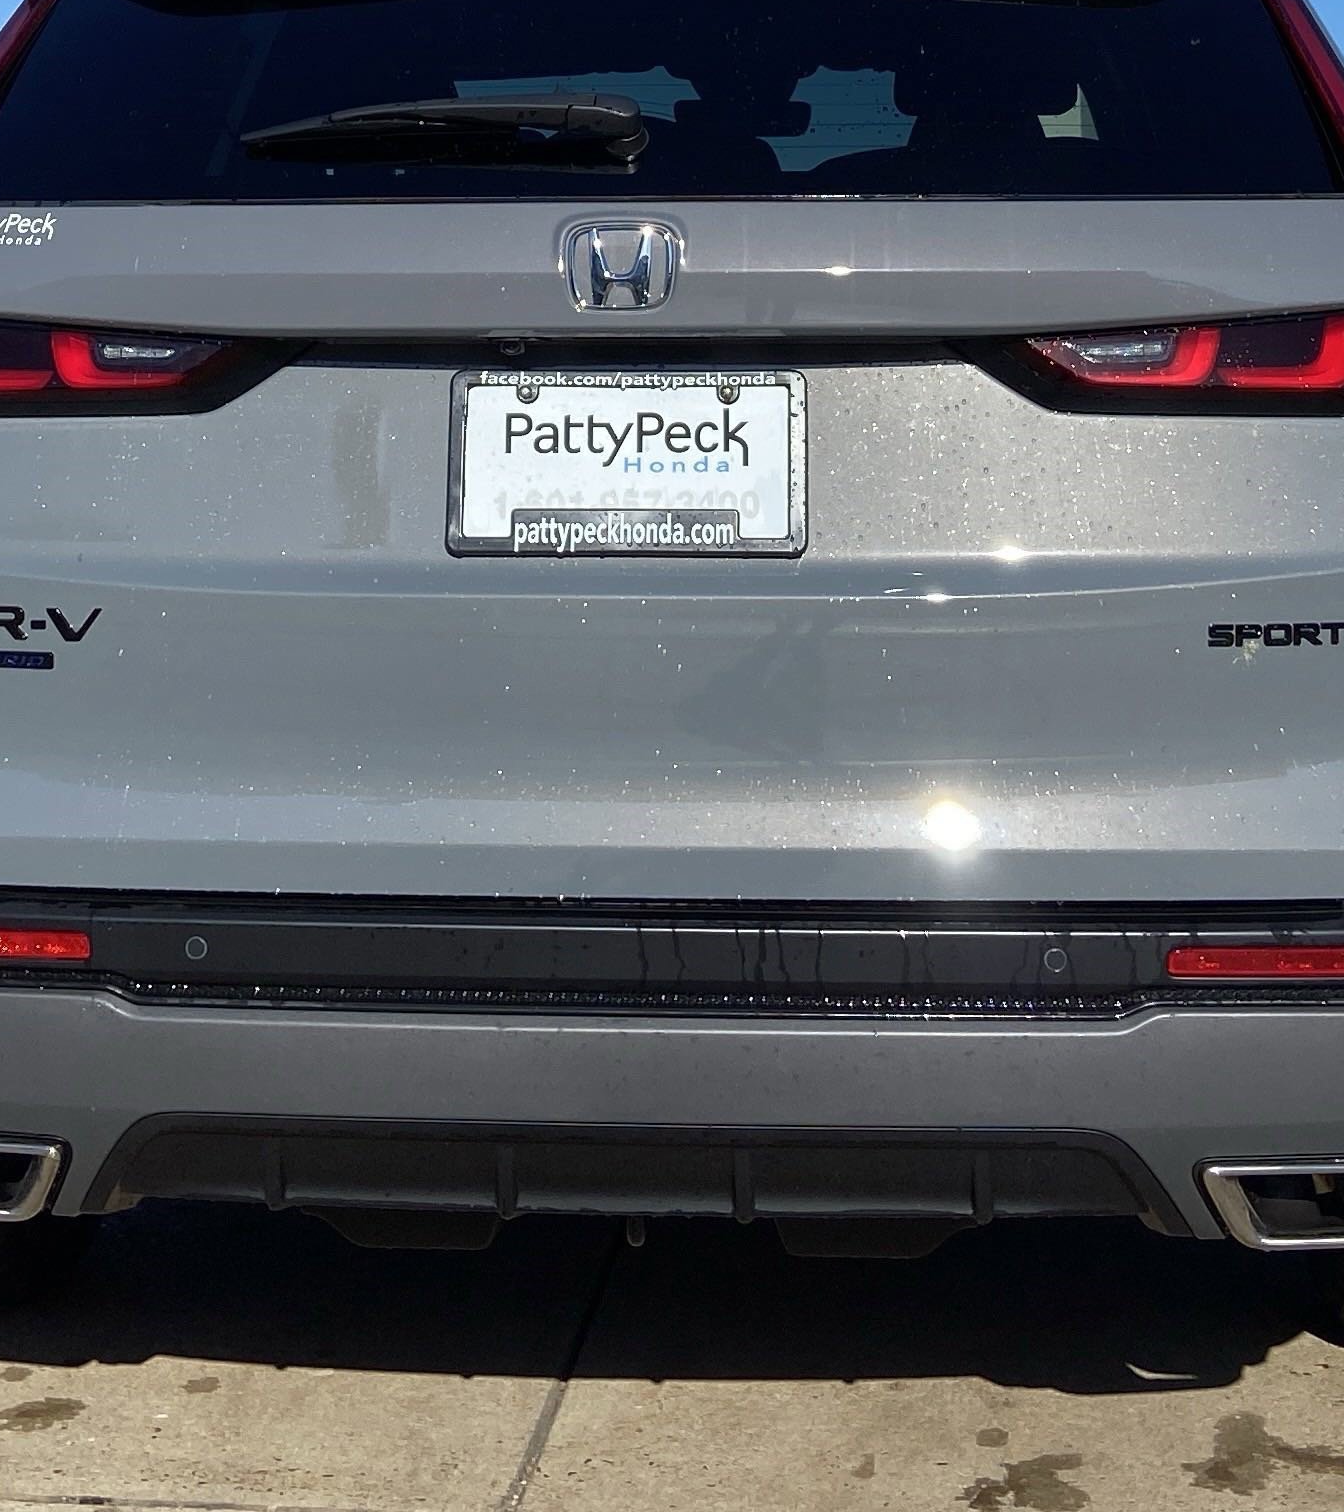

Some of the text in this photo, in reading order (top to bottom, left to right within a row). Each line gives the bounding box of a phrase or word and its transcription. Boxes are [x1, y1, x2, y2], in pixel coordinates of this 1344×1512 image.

[479, 371, 777, 390] facebook.com/pattypeckhonda
[504, 407, 750, 467] PattyPeck
[623, 456, 731, 473] Honda
[512, 512, 735, 553] pattypeckhonda.com
